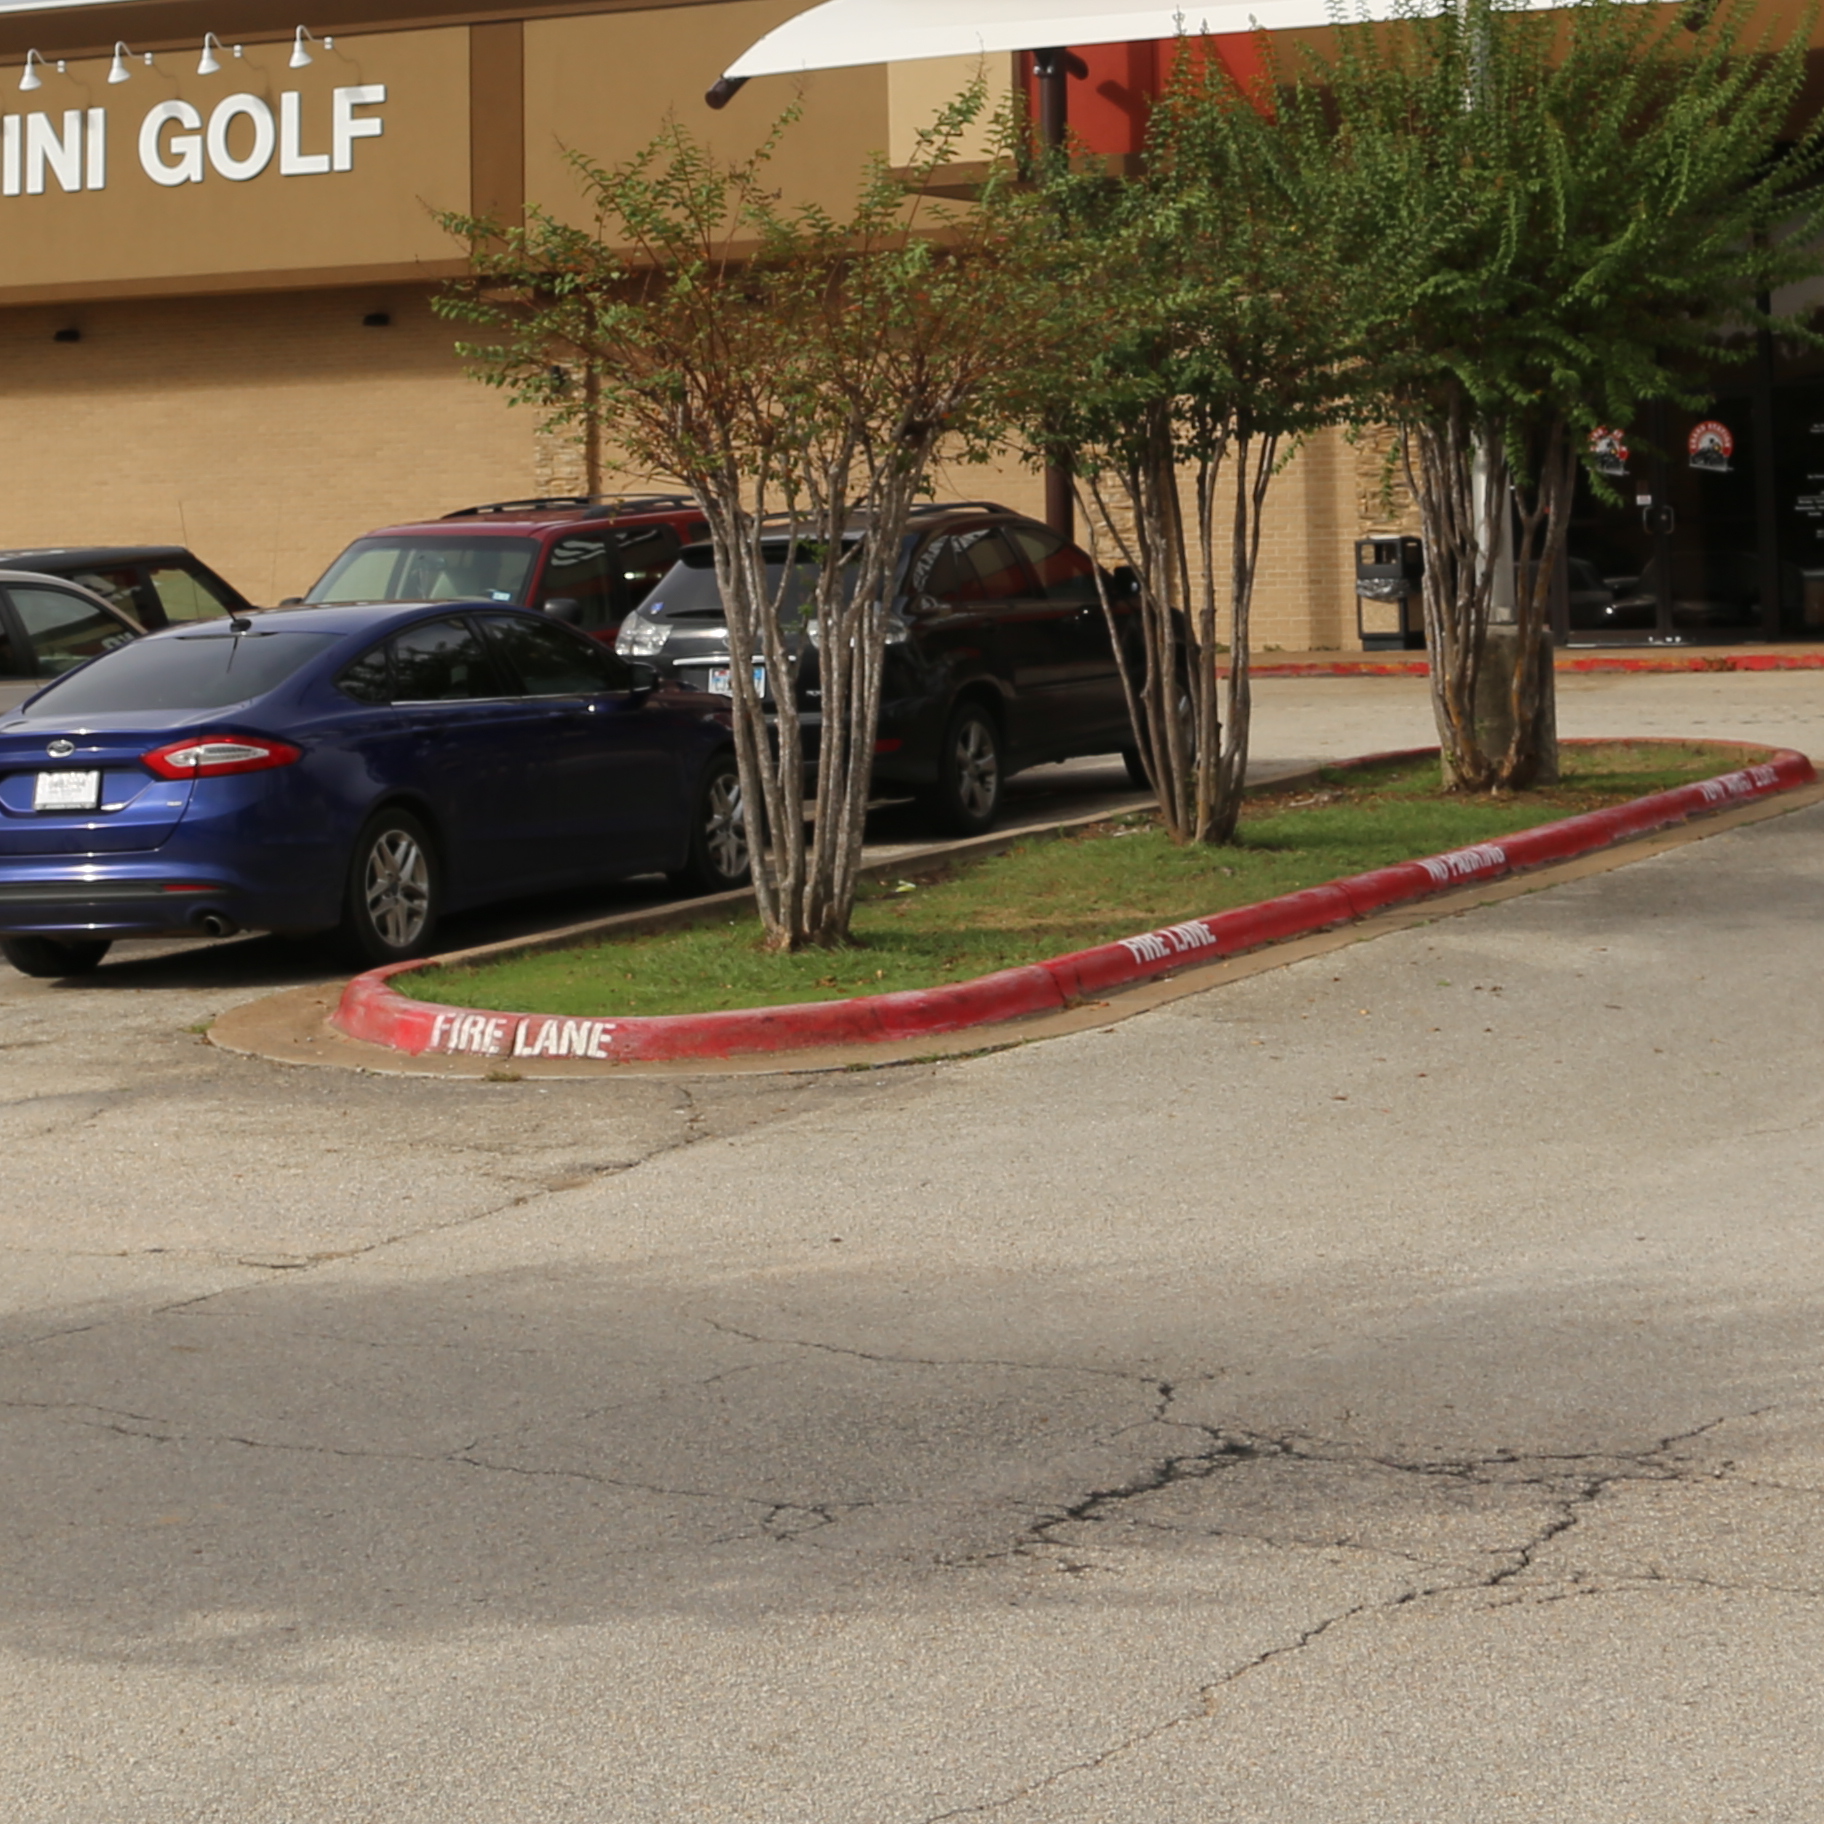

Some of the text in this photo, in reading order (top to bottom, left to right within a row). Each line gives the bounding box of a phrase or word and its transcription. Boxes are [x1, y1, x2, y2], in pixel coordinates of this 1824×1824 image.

[137, 84, 387, 187] GOLF
[1117, 920, 1217, 965] FIRE LANE
[429, 1012, 616, 1059] FIRE LANE
